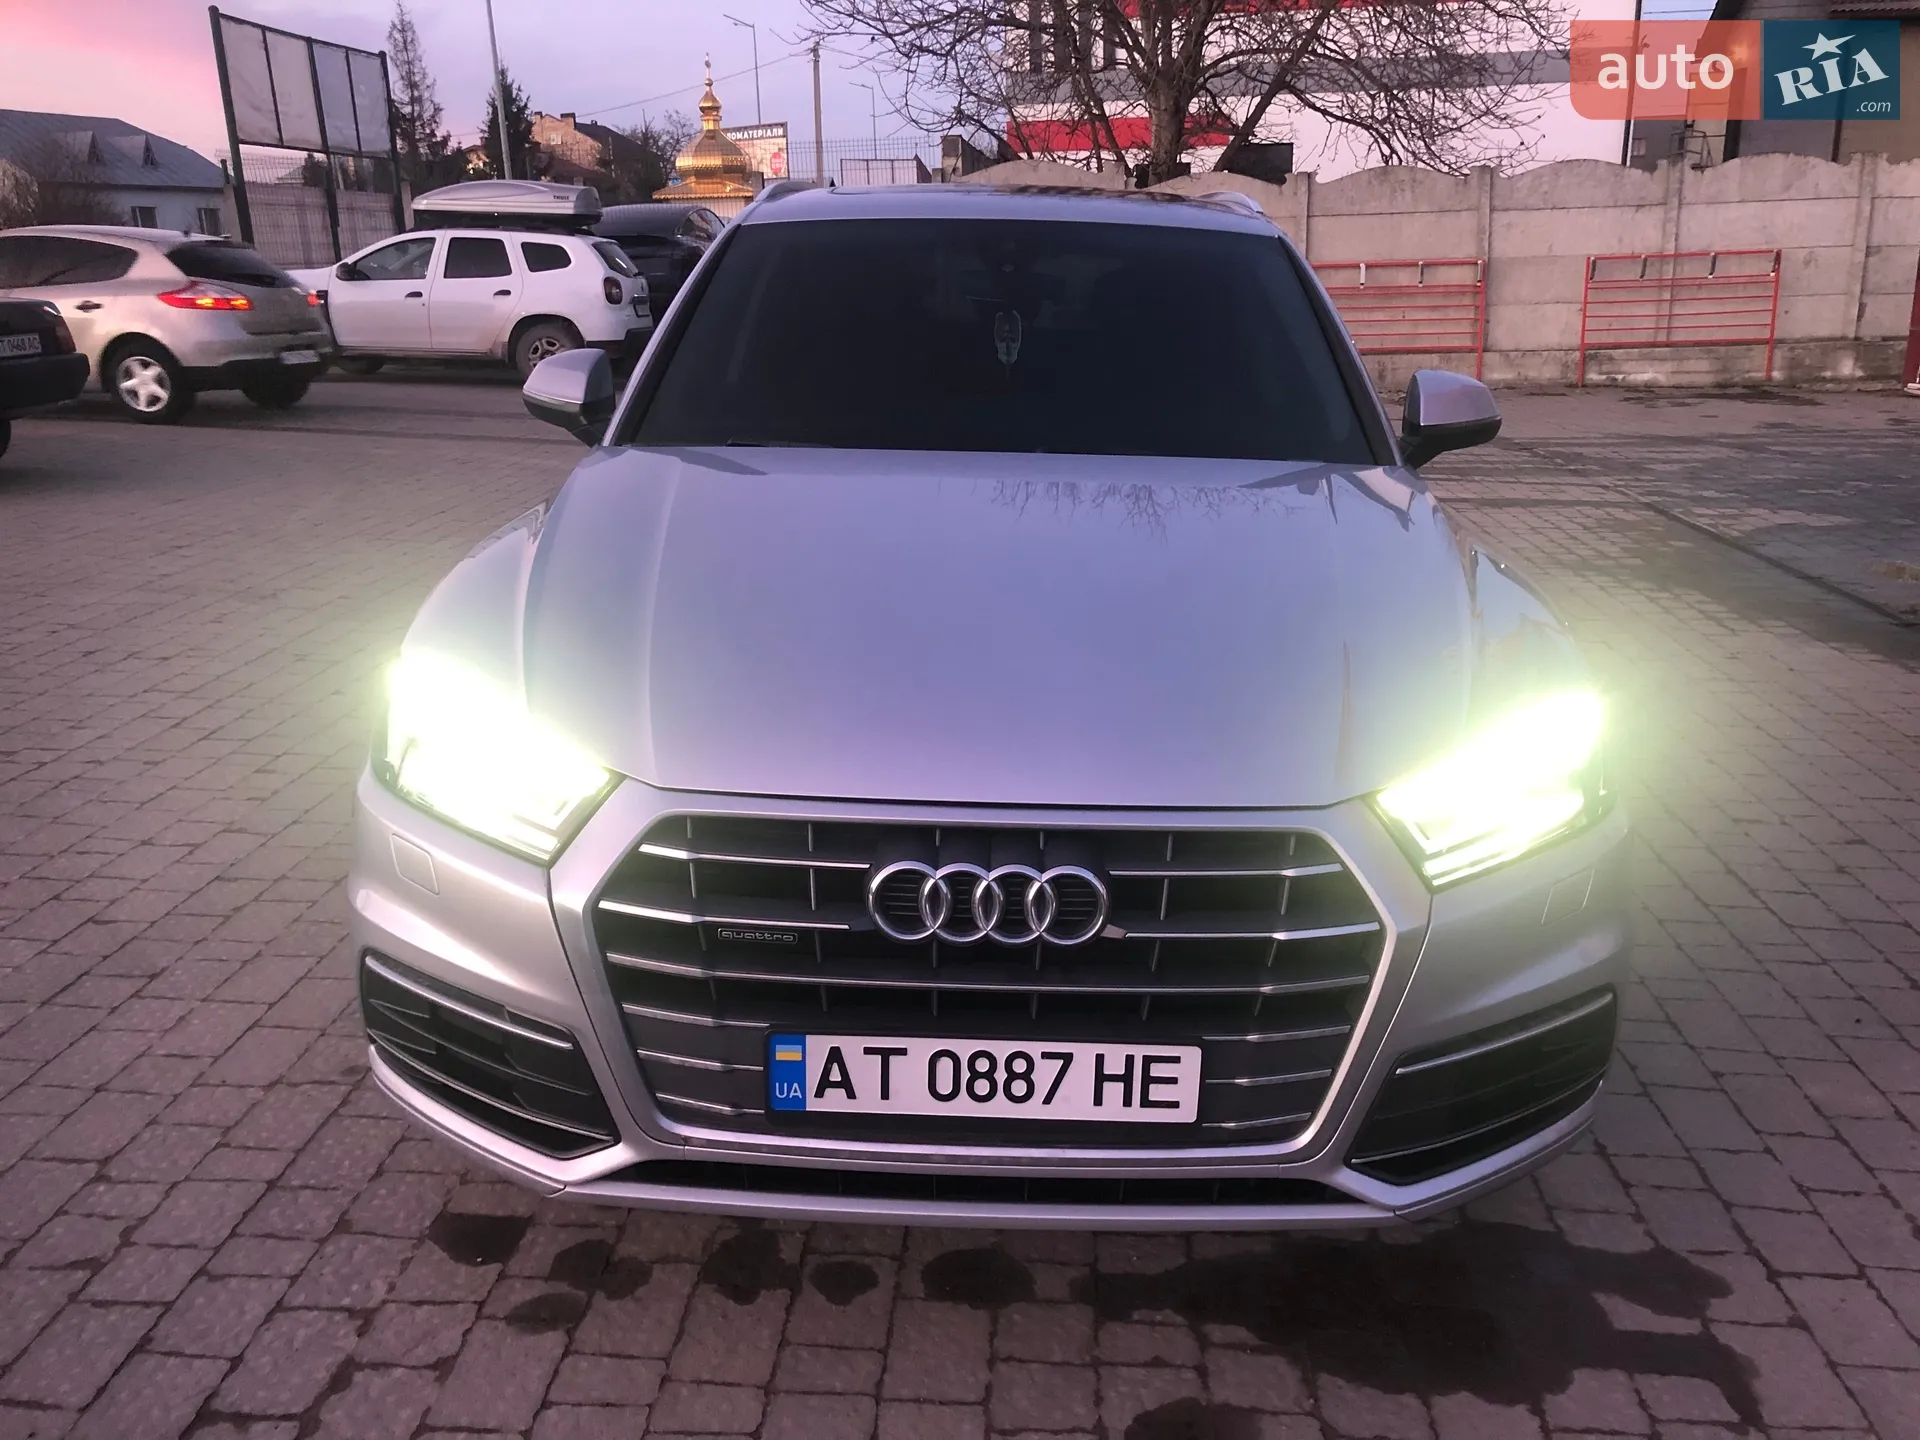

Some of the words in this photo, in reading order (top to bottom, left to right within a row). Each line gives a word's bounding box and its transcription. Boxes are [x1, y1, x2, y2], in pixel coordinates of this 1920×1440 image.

[721, 931, 794, 941] quattro
[813, 1046, 908, 1100] AT
[927, 1048, 1074, 1104] 0887
[1093, 1053, 1182, 1109] HE
[775, 1082, 802, 1099] UA
